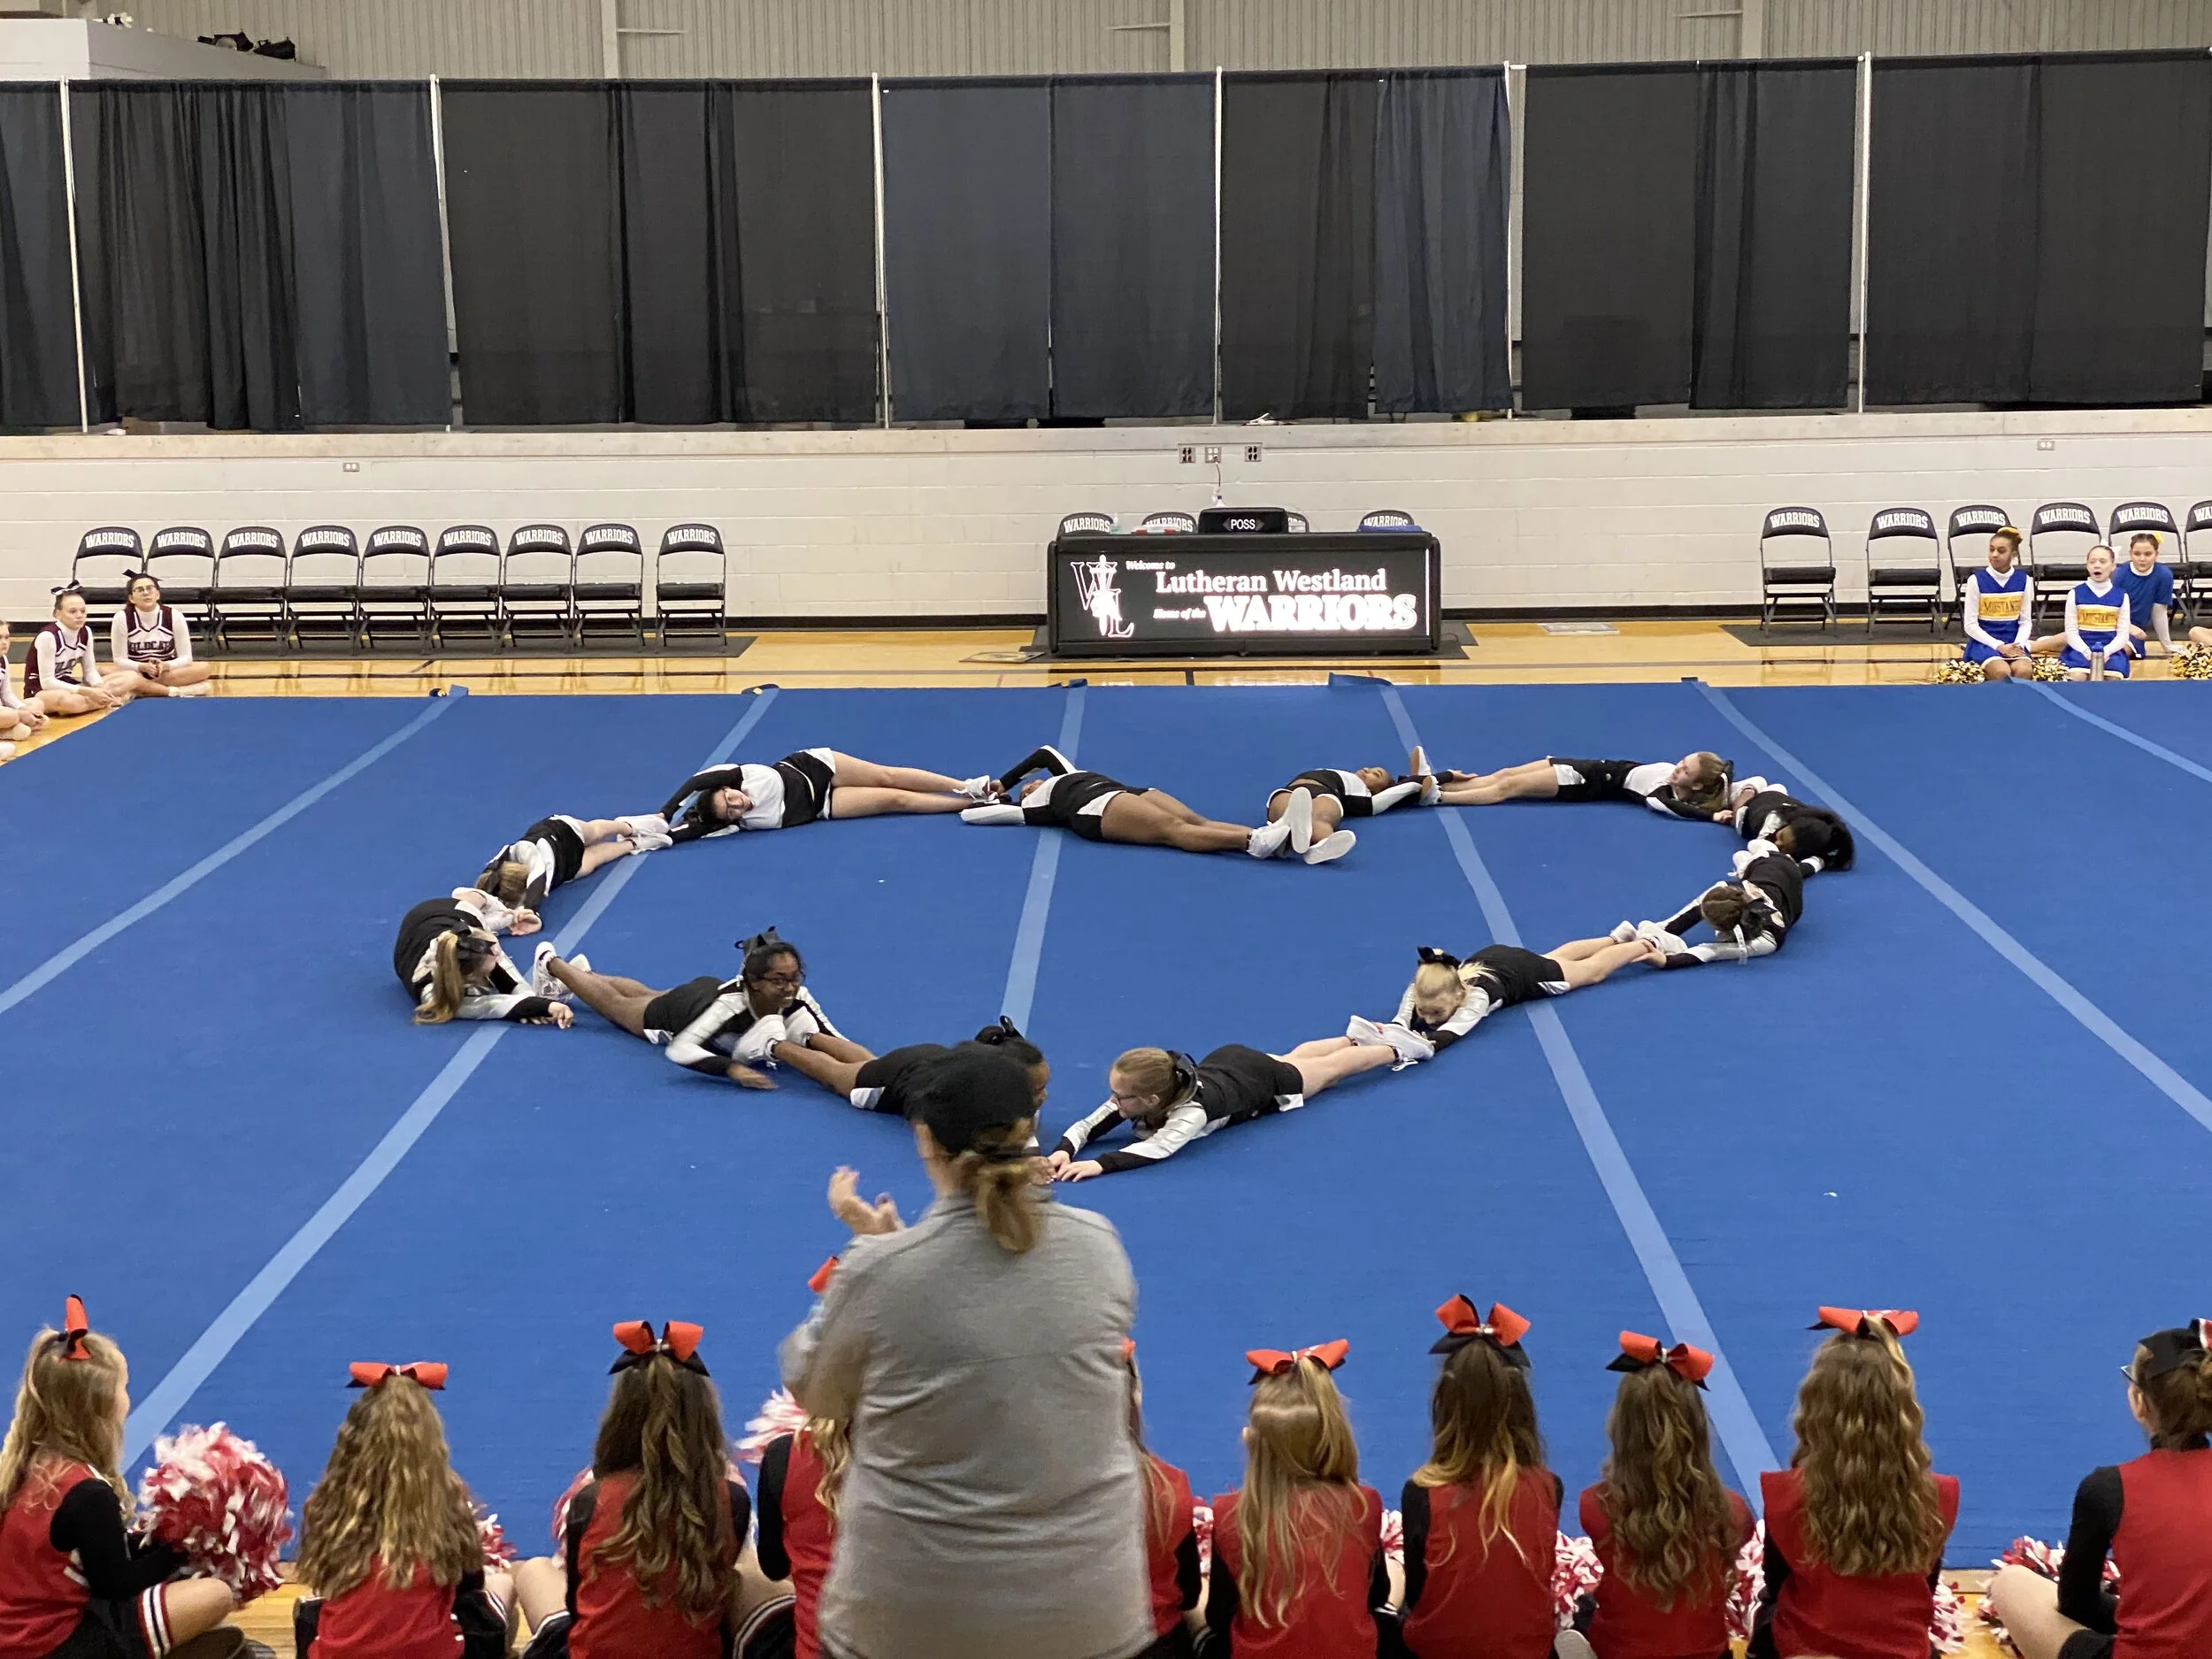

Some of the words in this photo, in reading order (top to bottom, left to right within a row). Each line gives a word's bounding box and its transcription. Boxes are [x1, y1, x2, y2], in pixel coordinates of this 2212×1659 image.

[1770, 512, 1819, 528] WARRIORS
[1877, 513, 1928, 529] WARRIORS
[1955, 511, 2006, 526] WARRIORS
[2039, 508, 2090, 524] WARRIORS
[2117, 507, 2168, 524] WARRIORS
[1064, 518, 1110, 533] WARRIORS
[1230, 518, 1256, 530] POSS
[85, 532, 134, 548] WARRIORS
[157, 532, 206, 548] WARRIORS
[228, 532, 279, 548] WARRIORS
[301, 531, 350, 547] WARRIORS
[373, 531, 422, 547] WARRIORS
[443, 531, 493, 546] WARRIORS
[516, 529, 565, 545] WARRIORS
[585, 529, 634, 545] WARRIORS
[667, 529, 716, 545] WARRIORS
[1125, 560, 1164, 571] Welcome
[1165, 561, 1176, 570] to
[1156, 570, 1268, 594] Lutheran
[1272, 568, 1387, 592] Westland
[1203, 594, 1417, 632] WARRIORS
